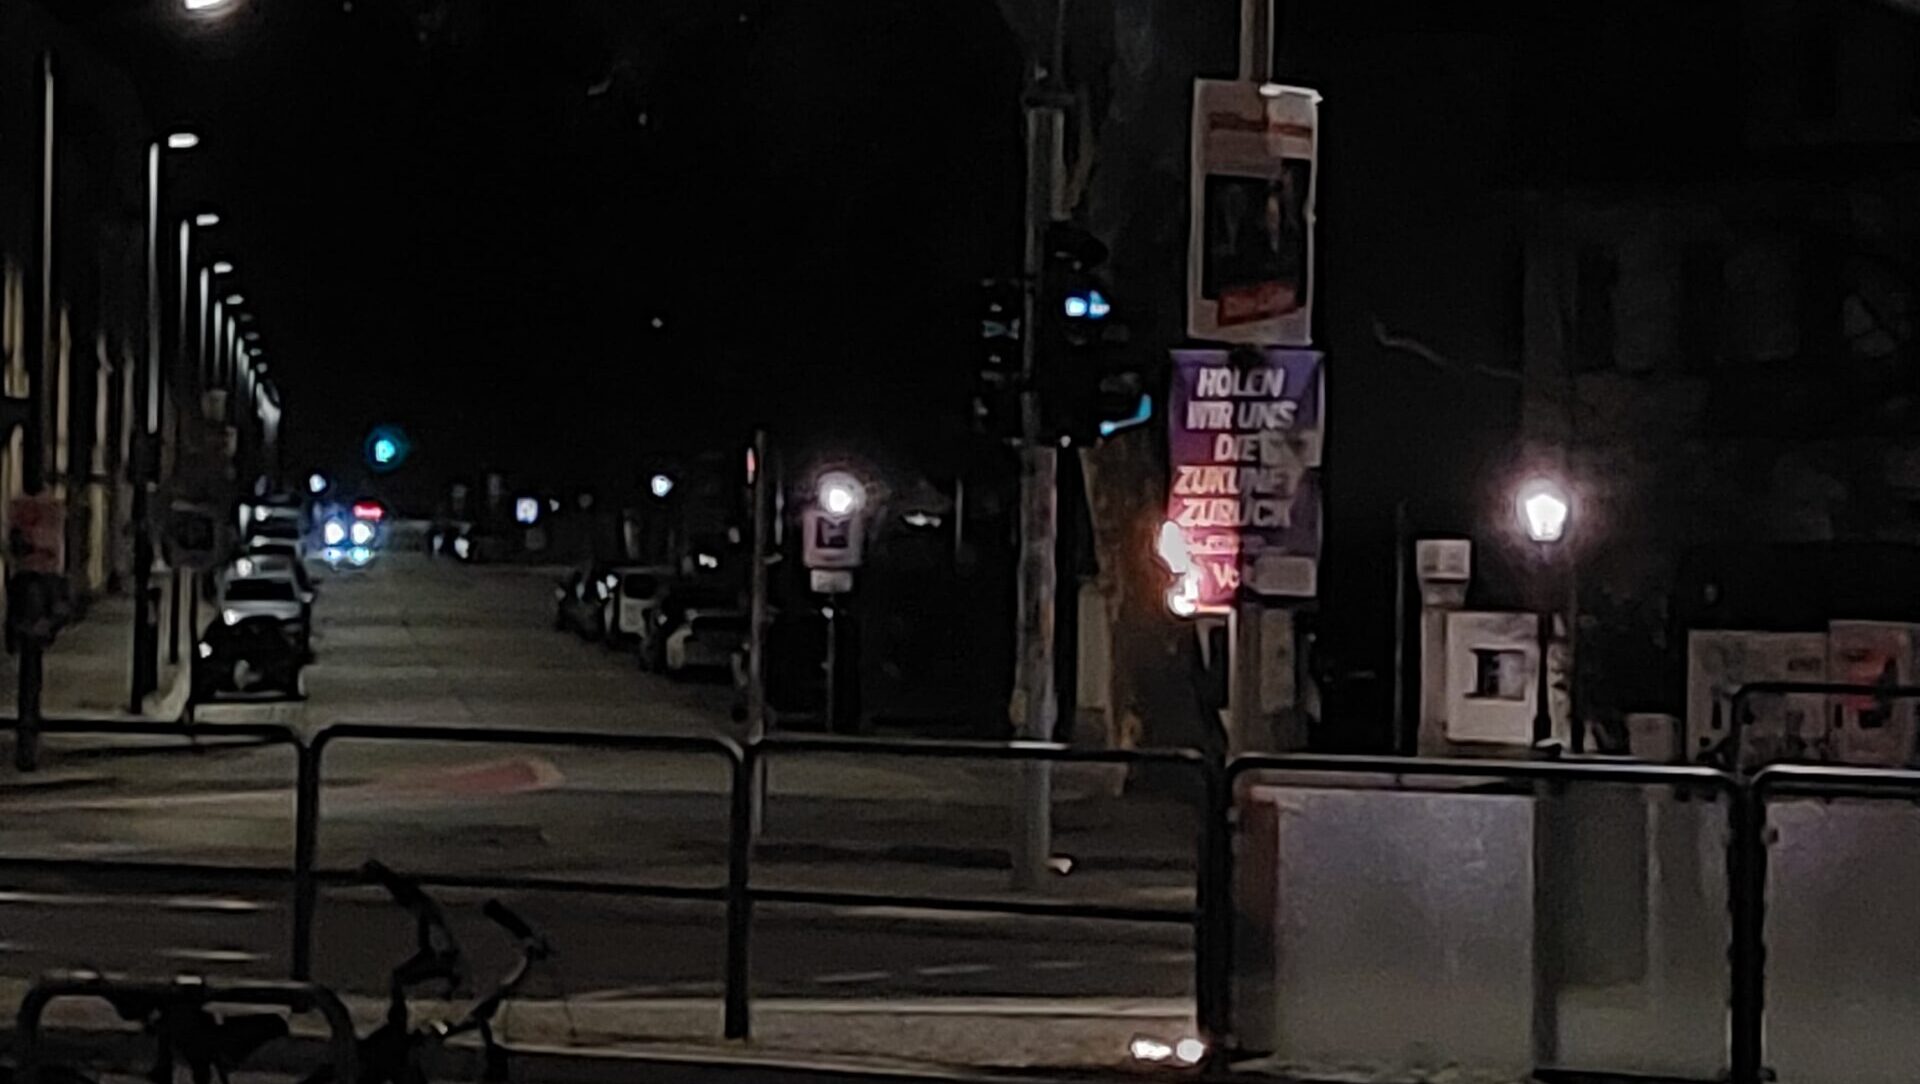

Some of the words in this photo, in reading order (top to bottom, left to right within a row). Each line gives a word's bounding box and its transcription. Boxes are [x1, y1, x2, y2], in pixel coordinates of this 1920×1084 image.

[1197, 367, 1286, 398] HOLEN
[1187, 400, 1234, 430] WIR
[1236, 399, 1299, 430] UNS
[1214, 432, 1258, 462] DIE
